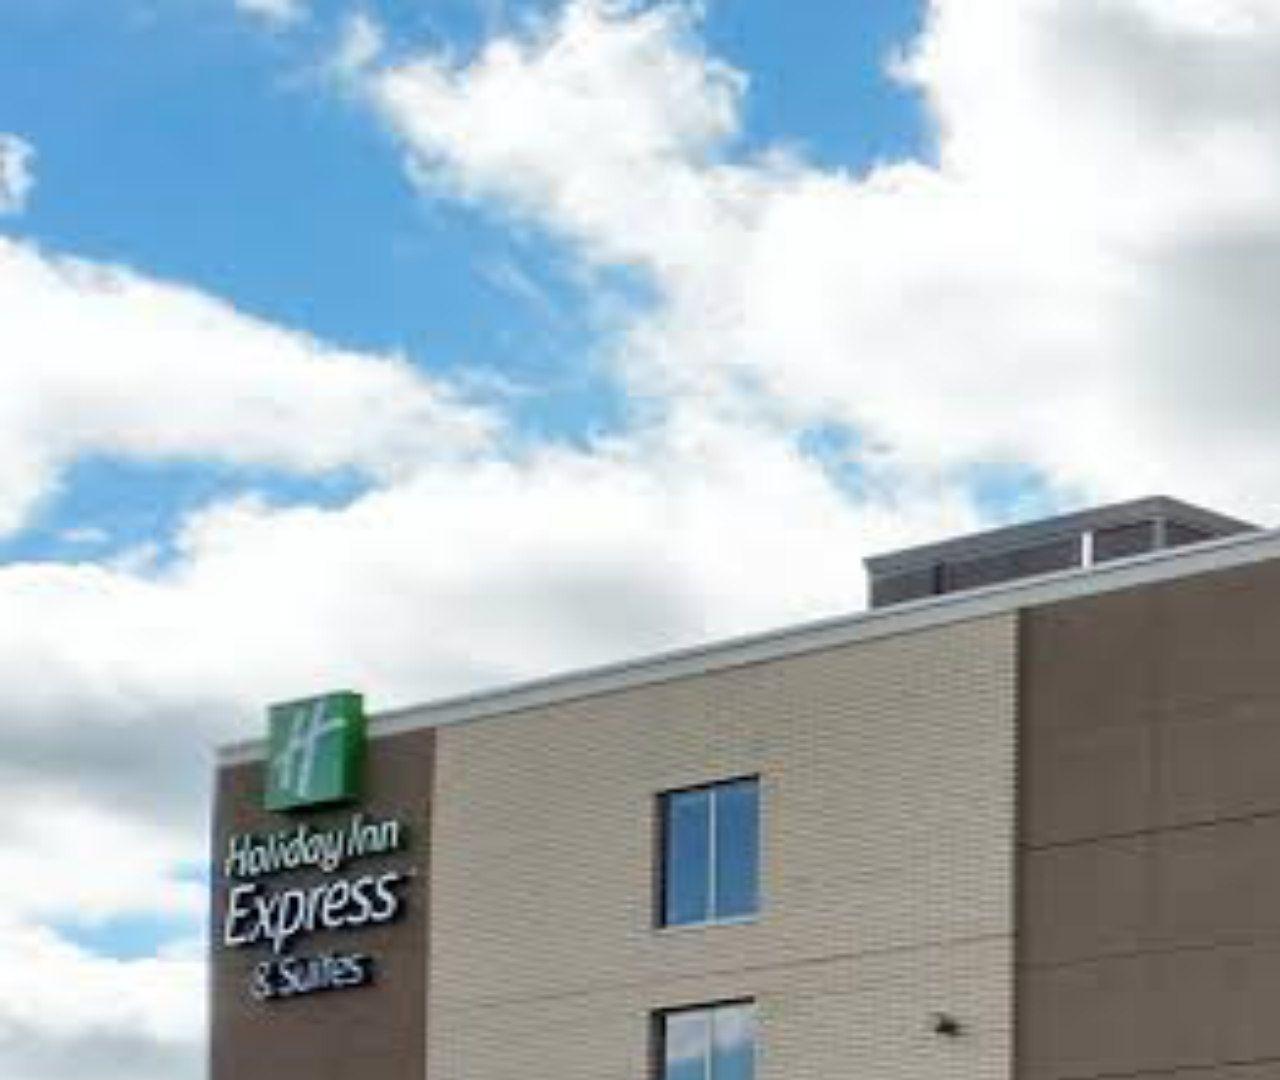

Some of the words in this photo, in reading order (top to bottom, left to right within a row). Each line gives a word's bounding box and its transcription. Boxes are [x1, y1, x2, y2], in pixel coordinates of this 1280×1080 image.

[225, 822, 344, 877] Holiday
[347, 813, 398, 856] Inn
[225, 872, 399, 953] Express
[251, 961, 271, 1000] &
[277, 952, 364, 995] Suites
